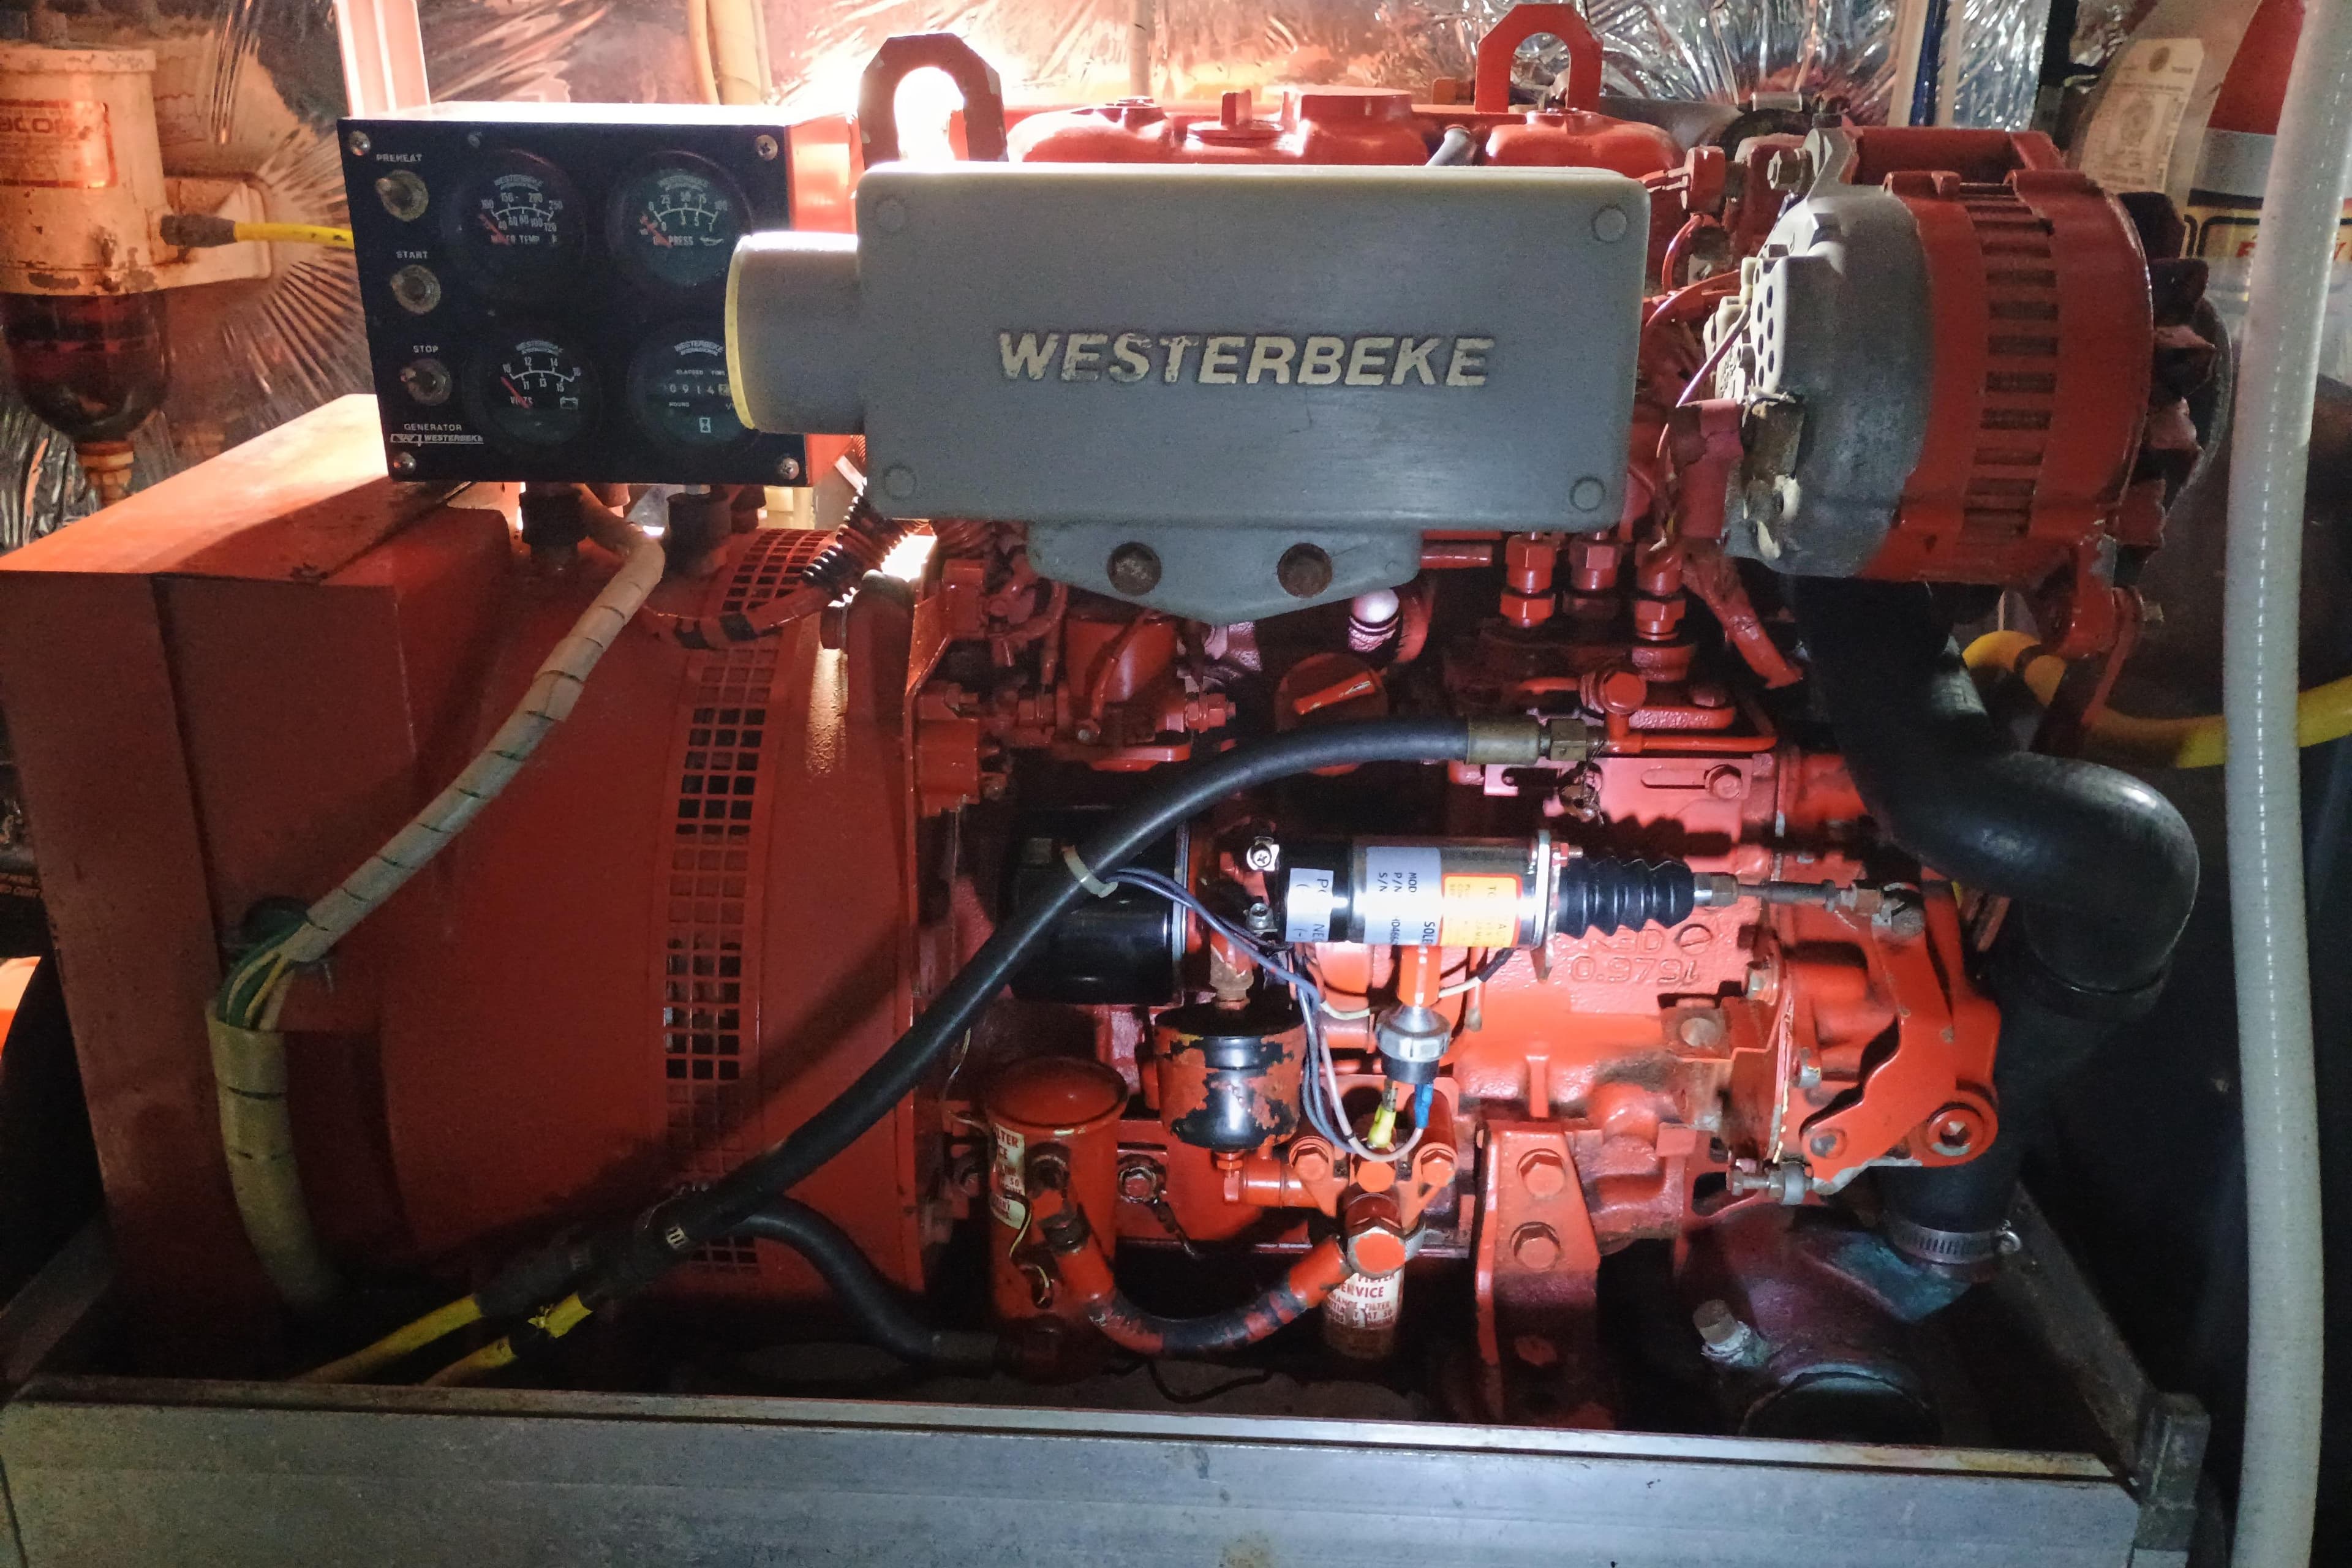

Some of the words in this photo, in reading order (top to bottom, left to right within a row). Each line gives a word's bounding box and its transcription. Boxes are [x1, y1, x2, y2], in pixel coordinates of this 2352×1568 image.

[376, 154, 422, 162] PREHEAT
[660, 195, 671, 204] 25
[396, 251, 428, 259] START
[413, 345, 439, 353] STOP
[525, 356, 532, 366] 12
[550, 358, 558, 367] 14
[998, 330, 1496, 386] WESTERBEKE
[524, 381, 529, 390] 11
[540, 378, 547, 387] 13
[557, 382, 565, 392] 15
[1377, 872, 1388, 892] S/N
[1392, 872, 1403, 892] P/N
[1337, 1283, 1384, 1298] ERVICE
